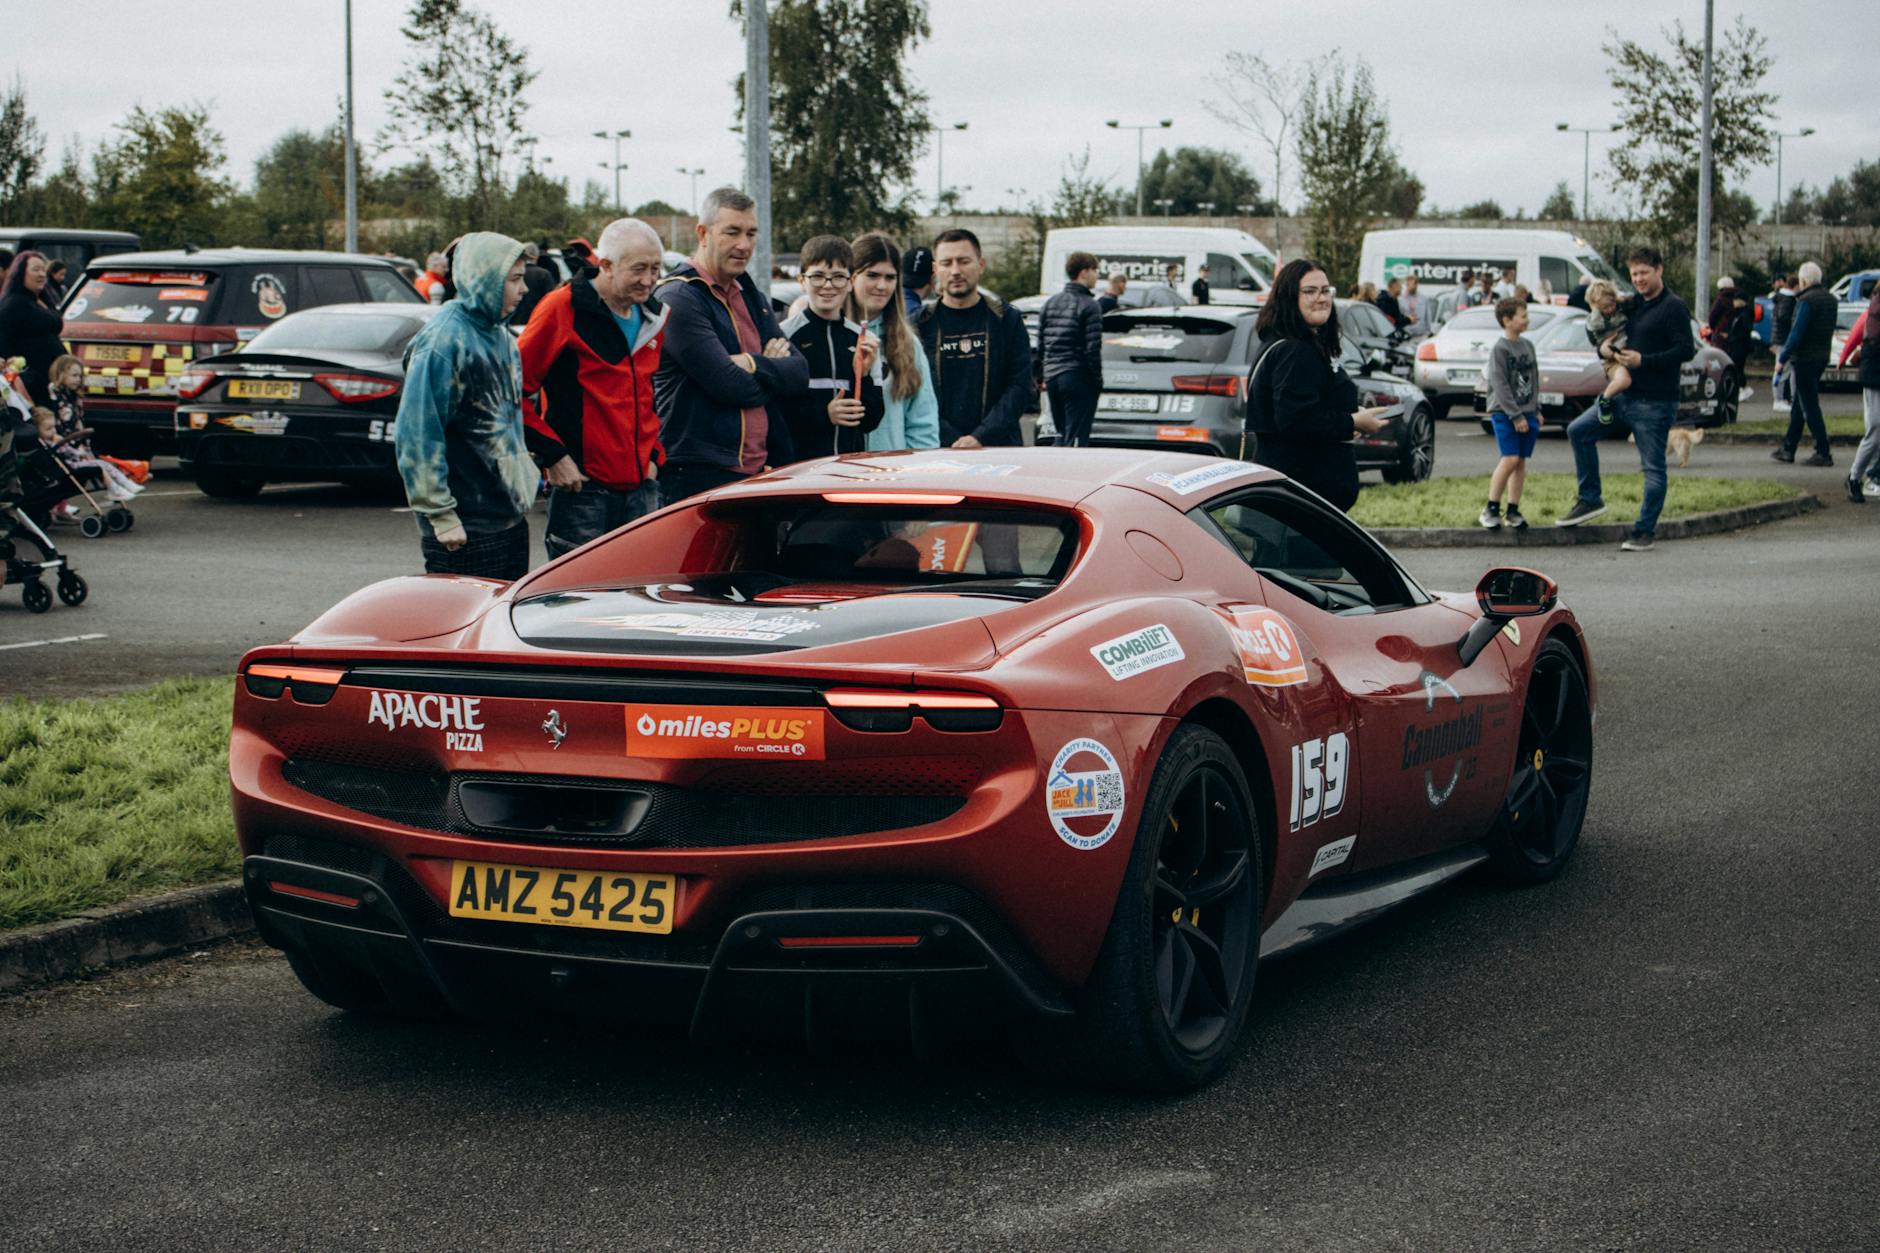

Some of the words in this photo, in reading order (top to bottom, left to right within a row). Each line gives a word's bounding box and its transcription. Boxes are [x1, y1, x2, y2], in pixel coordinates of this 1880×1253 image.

[166, 306, 199, 323] 70
[1163, 394, 1195, 413] 113
[1112, 658, 1141, 677] LIFTING
[1142, 647, 1179, 668] INNOVATION
[368, 691, 486, 732] APACHE
[446, 732, 484, 752] PIZZA
[756, 744, 790, 753] CIRCLE
[1055, 742, 1081, 768] CHARITY
[1290, 731, 1350, 833] 159
[1059, 826, 1078, 845] SCAN
[1079, 839, 1089, 847] TO
[1090, 822, 1117, 847] DONATE
[455, 865, 541, 915] AMZ
[550, 873, 667, 925] 5425
